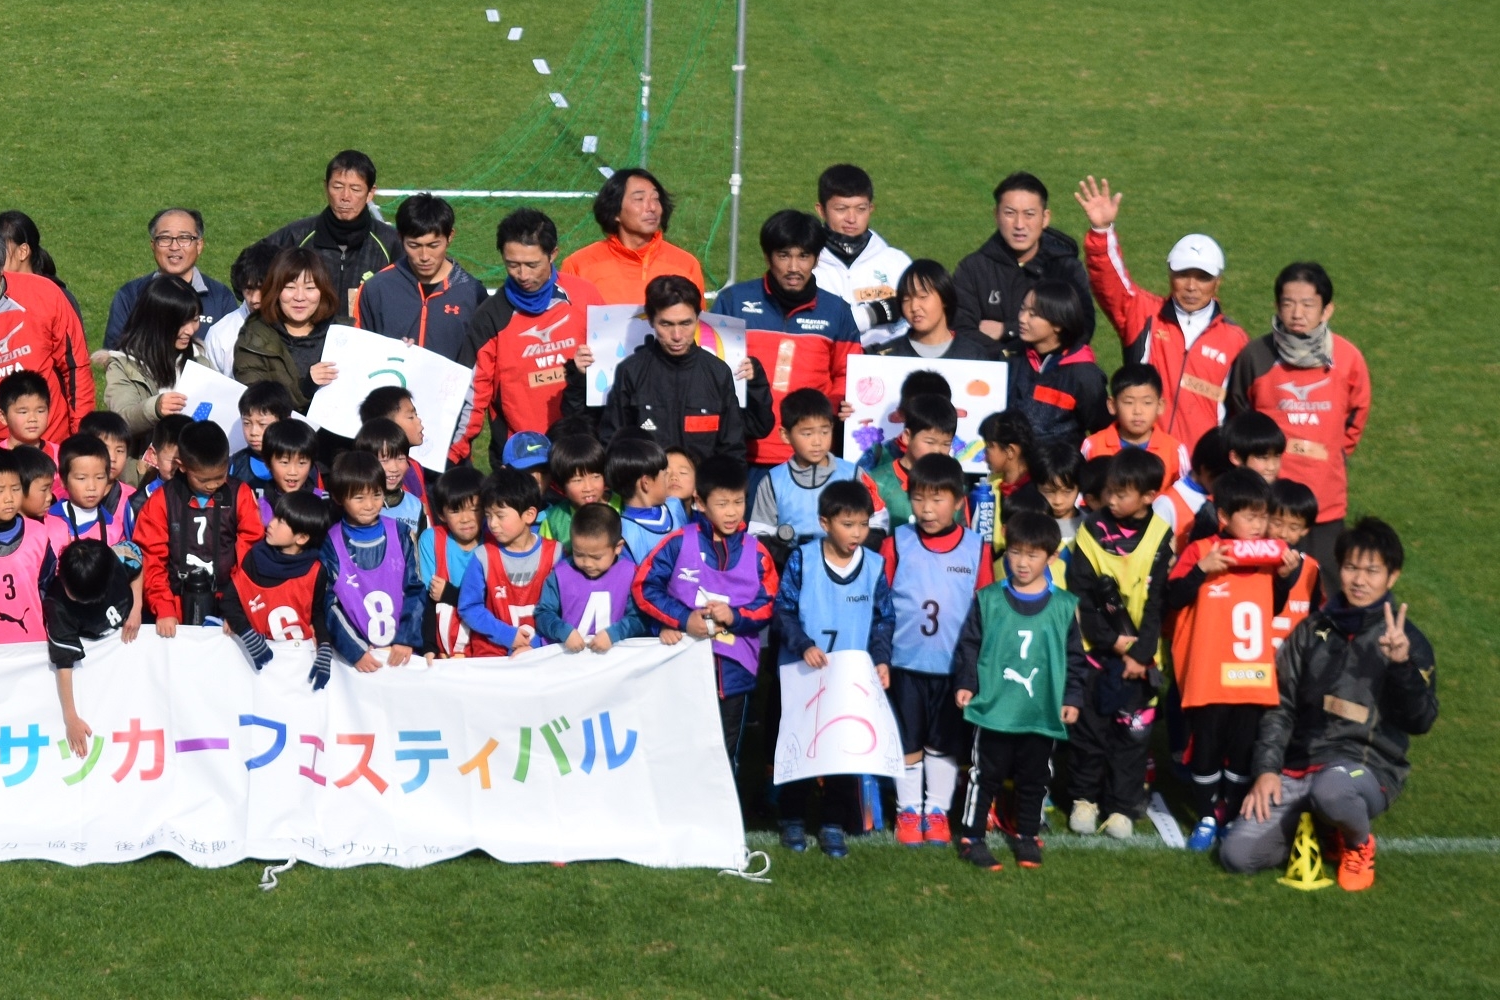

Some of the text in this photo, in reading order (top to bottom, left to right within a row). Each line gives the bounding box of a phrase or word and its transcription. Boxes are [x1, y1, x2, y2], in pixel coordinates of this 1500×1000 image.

[521, 337, 576, 358] MIZUNO
[1201, 345, 1227, 365] WFA
[535, 353, 567, 369] WFA
[1276, 399, 1332, 412] MIZUNO
[1287, 412, 1320, 425] WFA
[193, 516, 207, 545] 7
[2, 573, 15, 600] 3
[106, 605, 123, 627] 8
[363, 590, 396, 647] 8
[920, 600, 940, 636] 3
[1289, 600, 1311, 613] WF
[268, 605, 304, 641] 6
[1231, 601, 1264, 661] 9
[821, 629, 838, 654] 7
[1017, 630, 1033, 660] 7
